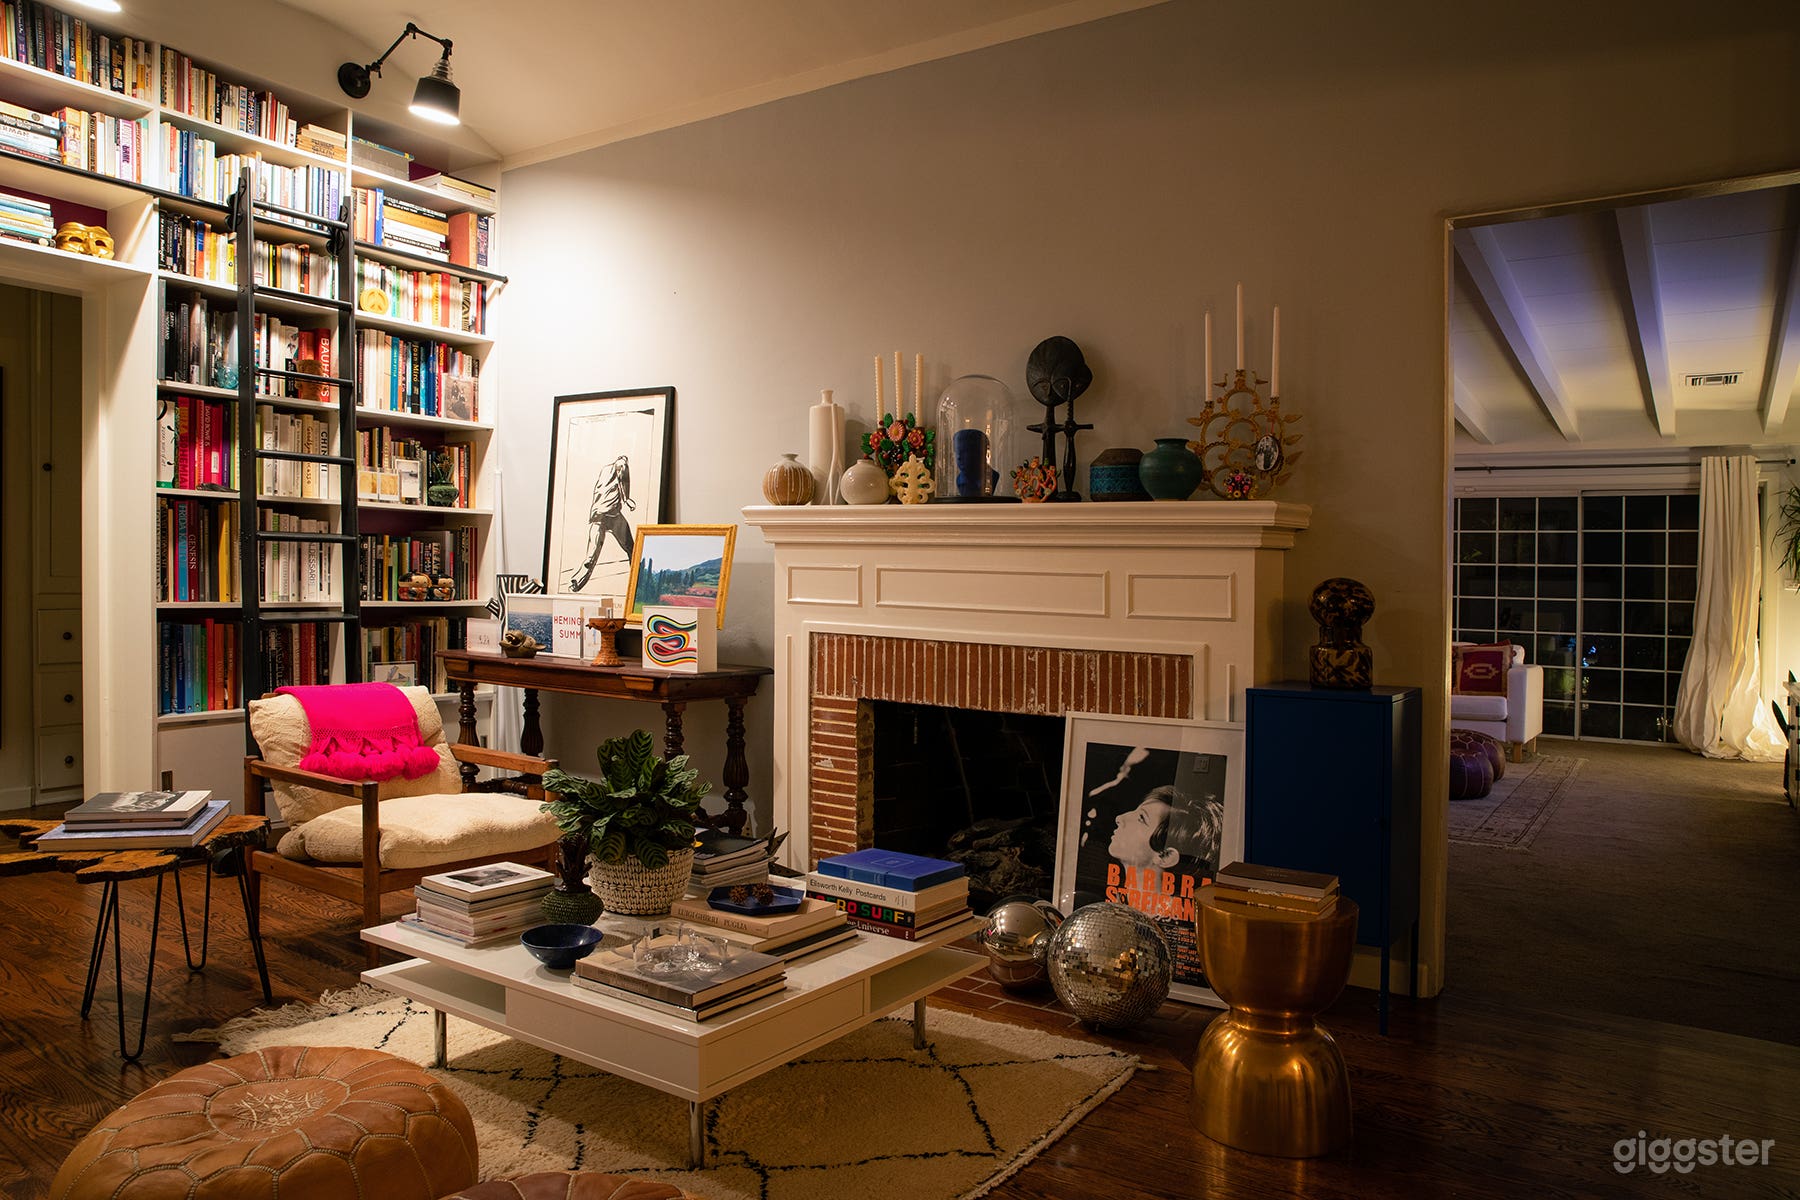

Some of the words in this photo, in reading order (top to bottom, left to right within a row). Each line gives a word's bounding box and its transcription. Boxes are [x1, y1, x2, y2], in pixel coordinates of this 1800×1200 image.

[321, 337, 330, 397] BAUHAS
[320, 431, 328, 472] CHINTI
[188, 534, 196, 570] GENESIS
[553, 616, 582, 626] HEMING
[559, 629, 582, 640] SUMM
[809, 878, 838, 892] Ellsworth
[838, 884, 854, 896] Kelly
[855, 887, 886, 902] Postcards
[1105, 886, 1195, 922] STREISAN
[678, 908, 695, 919] LUIGI
[723, 919, 748, 931] PUGLIA
[857, 920, 890, 935] Universe
